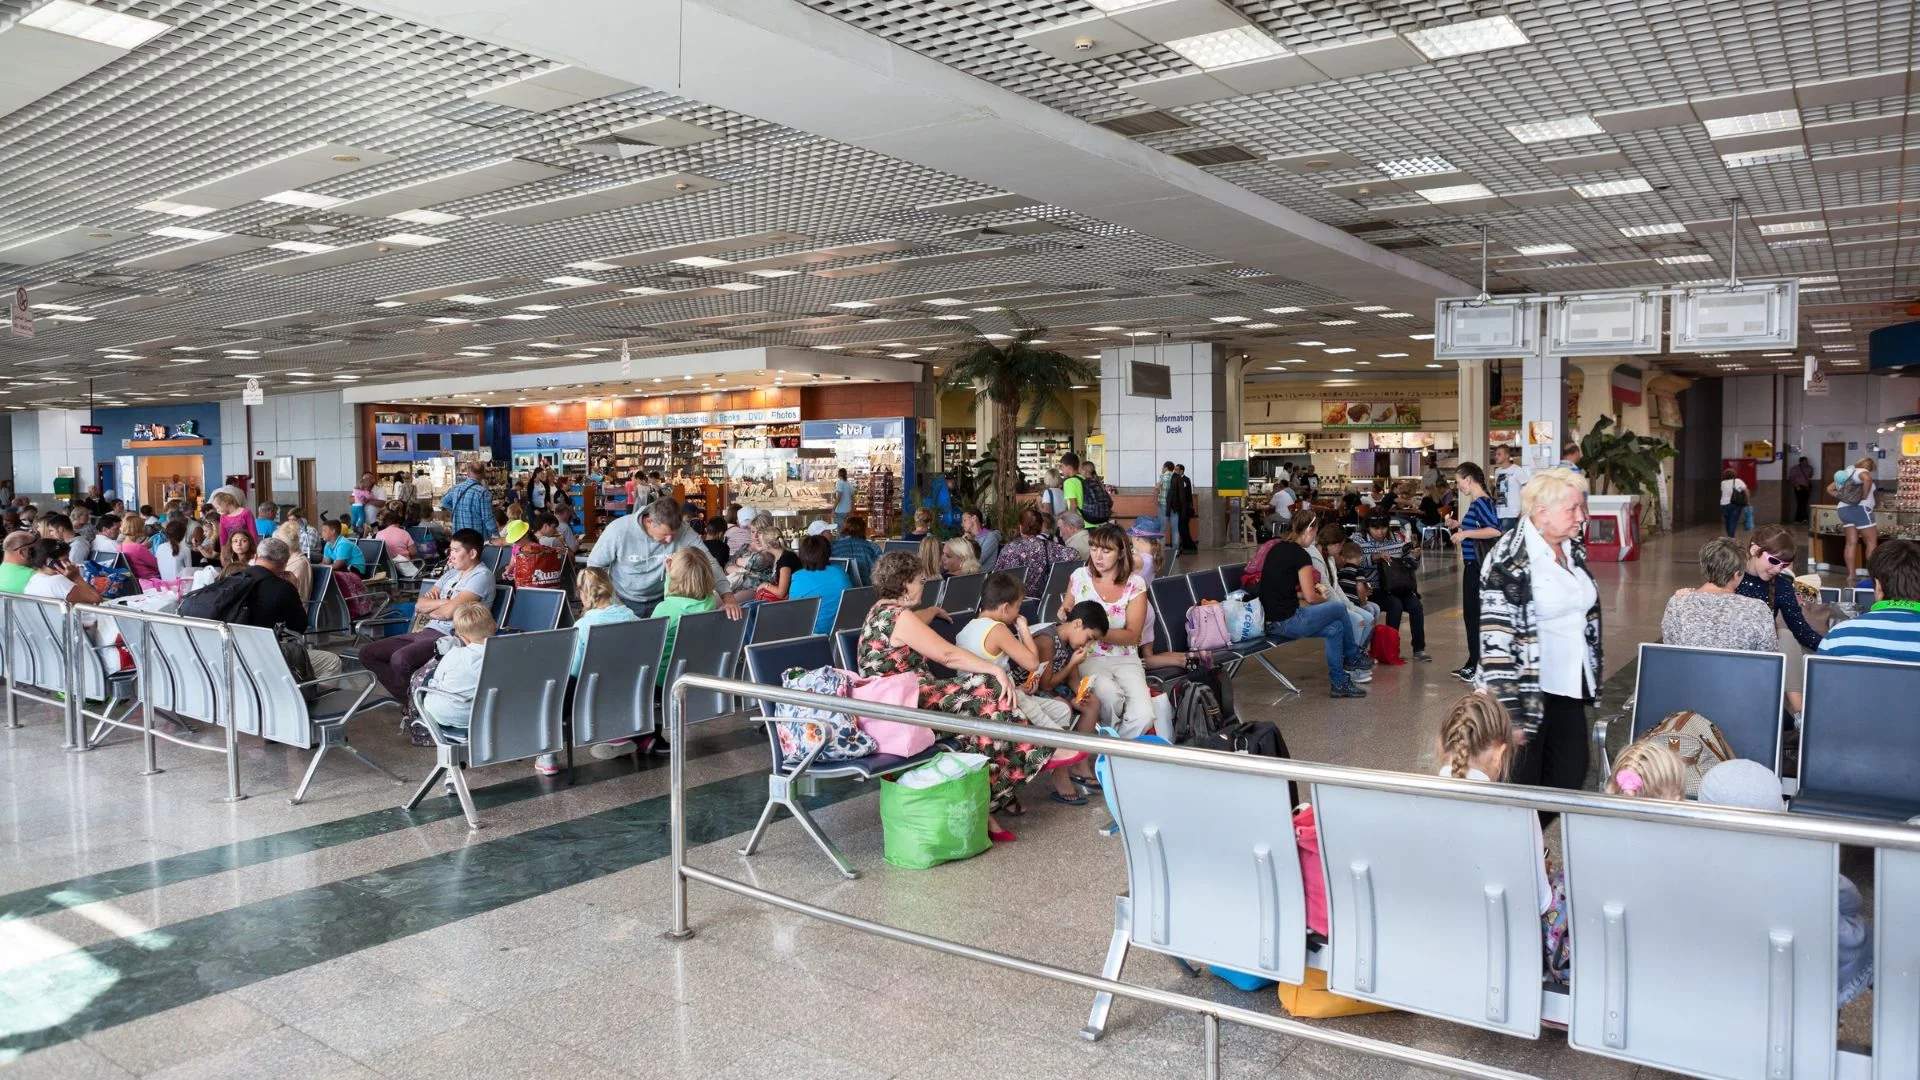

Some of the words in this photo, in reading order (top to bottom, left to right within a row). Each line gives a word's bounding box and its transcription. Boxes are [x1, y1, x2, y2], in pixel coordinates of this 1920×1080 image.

[748, 411, 763, 421] DVD
[771, 411, 797, 420] Photos
[1155, 414, 1193, 423] Information
[835, 423, 864, 435] Silver
[1166, 425, 1182, 434] Desk
